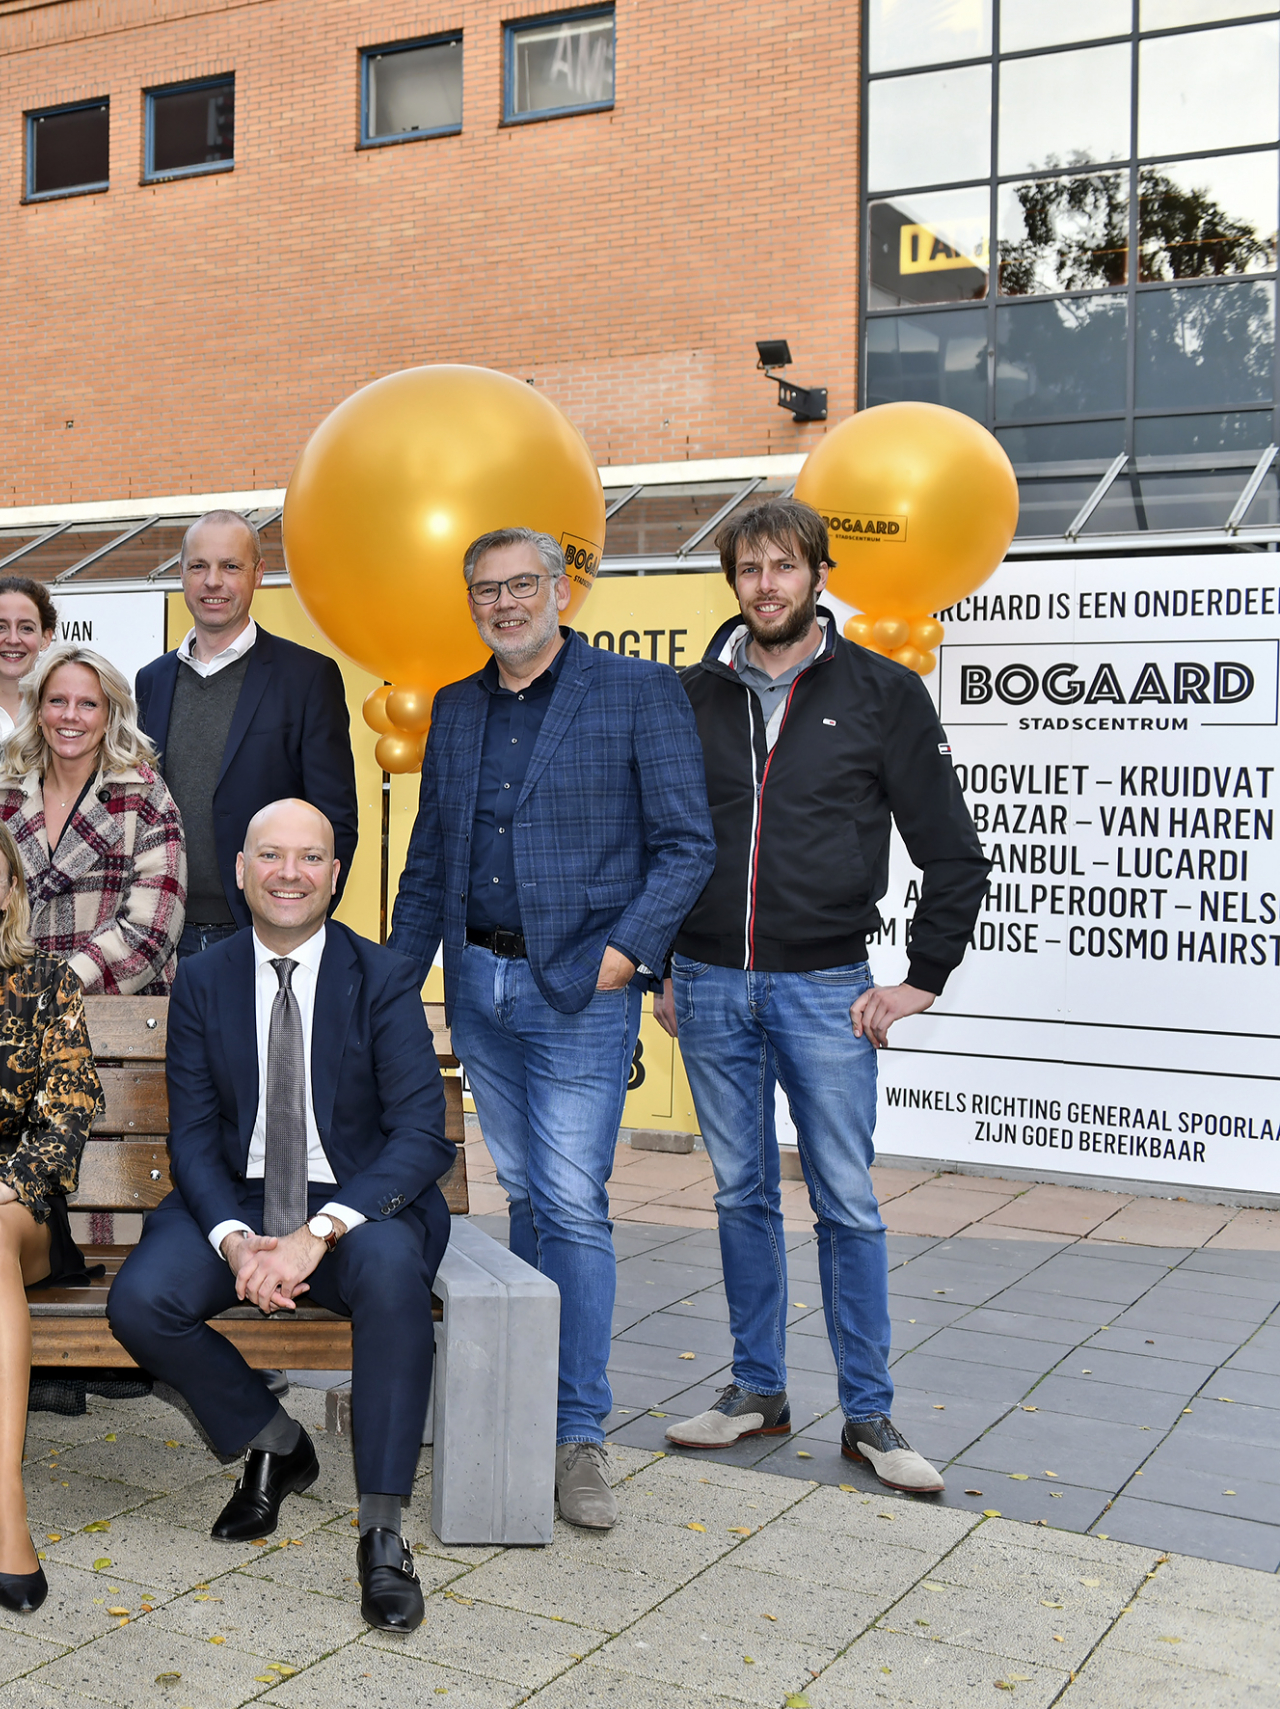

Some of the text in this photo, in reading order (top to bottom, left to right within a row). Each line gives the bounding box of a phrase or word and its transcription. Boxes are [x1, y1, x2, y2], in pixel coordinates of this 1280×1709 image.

[822, 515, 900, 535] BOGAARD
[835, 533, 881, 542] STADSCENTRUM
[1048, 592, 1070, 620] IS
[1079, 590, 1126, 619] EEN
[1134, 586, 1280, 618] ONDERDEE
[61, 620, 92, 641] VAN
[960, 661, 1255, 706] BOGAARD
[1018, 717, 1189, 731] STADSCENTRUM
[1120, 765, 1275, 799] KRUIDVAT
[973, 803, 1068, 835] BAZAR
[1099, 805, 1160, 838] VAN
[1168, 806, 1274, 841] HAREN
[1117, 846, 1248, 882] LUCARDI
[1199, 889, 1280, 925] NELS
[1068, 925, 1168, 961] COSMO
[885, 1086, 967, 1113] WINKELS
[971, 1093, 1062, 1121] RICHTING
[1067, 1101, 1173, 1132] GENERAAL
[974, 1120, 1206, 1163] ZIJN GOED BEREIKBAAR
